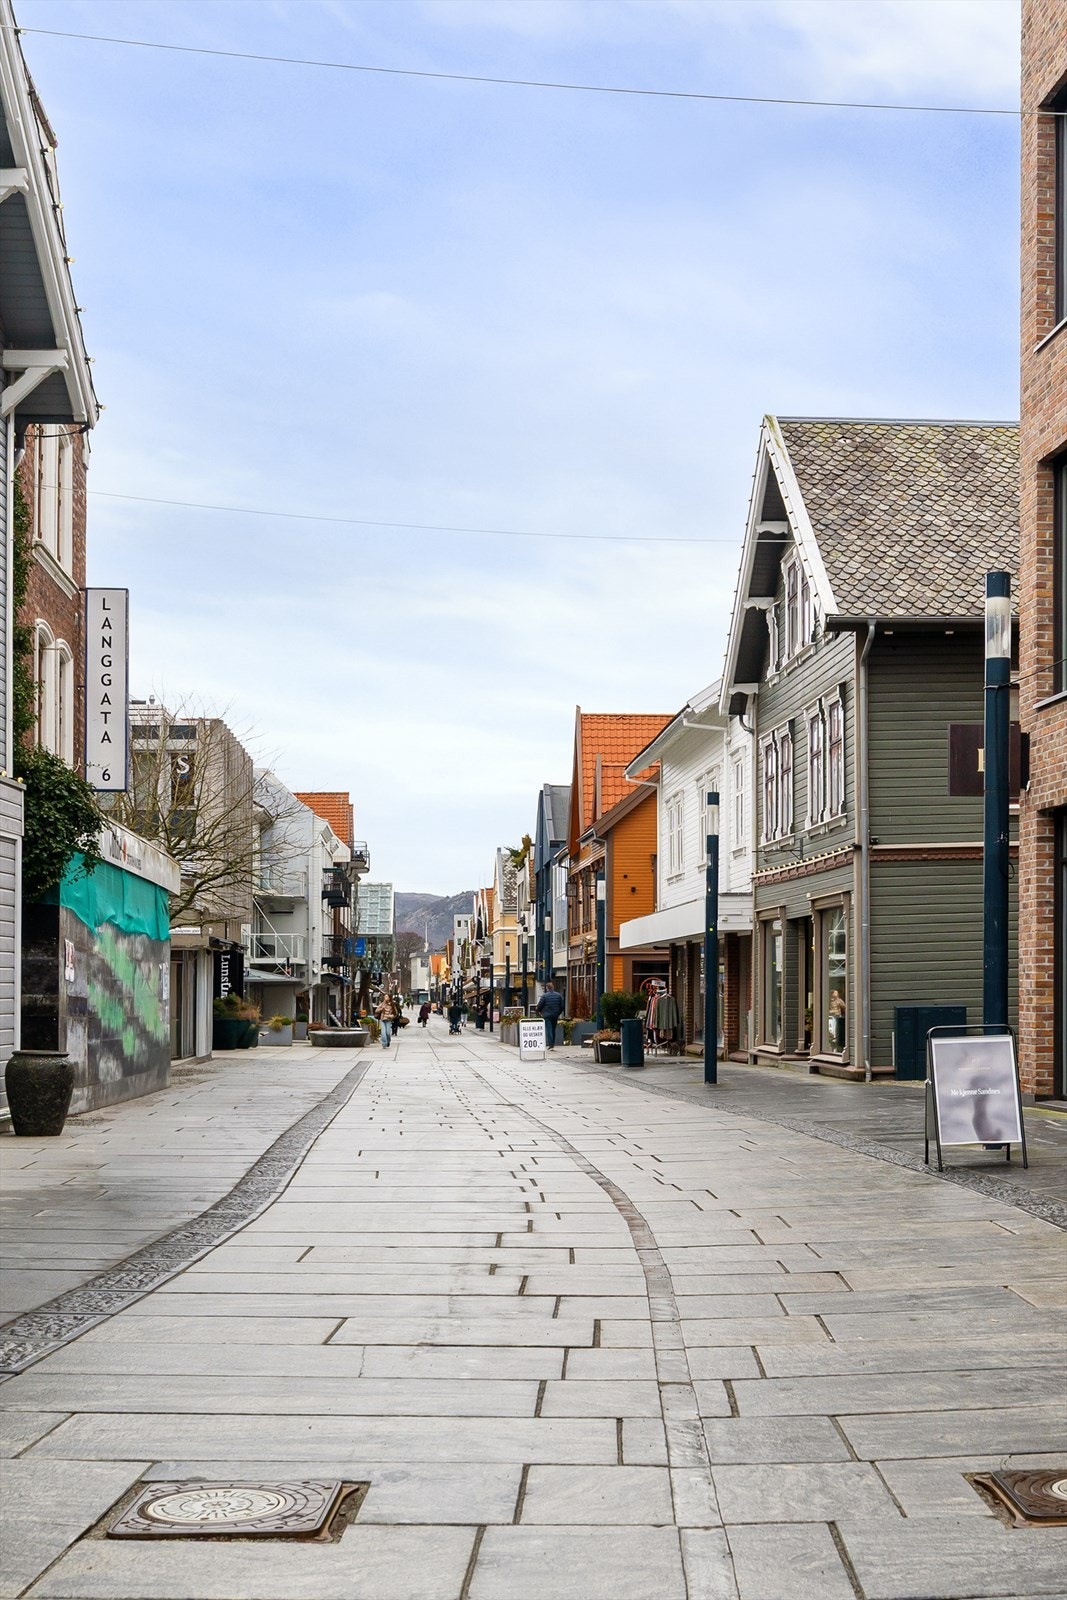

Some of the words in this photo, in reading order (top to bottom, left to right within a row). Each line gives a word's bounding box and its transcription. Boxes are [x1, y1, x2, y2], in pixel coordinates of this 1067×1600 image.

[100, 597, 112, 744] LANGGATA
[102, 768, 111, 782] 6
[978, 1088, 1001, 1096] Sandnes
